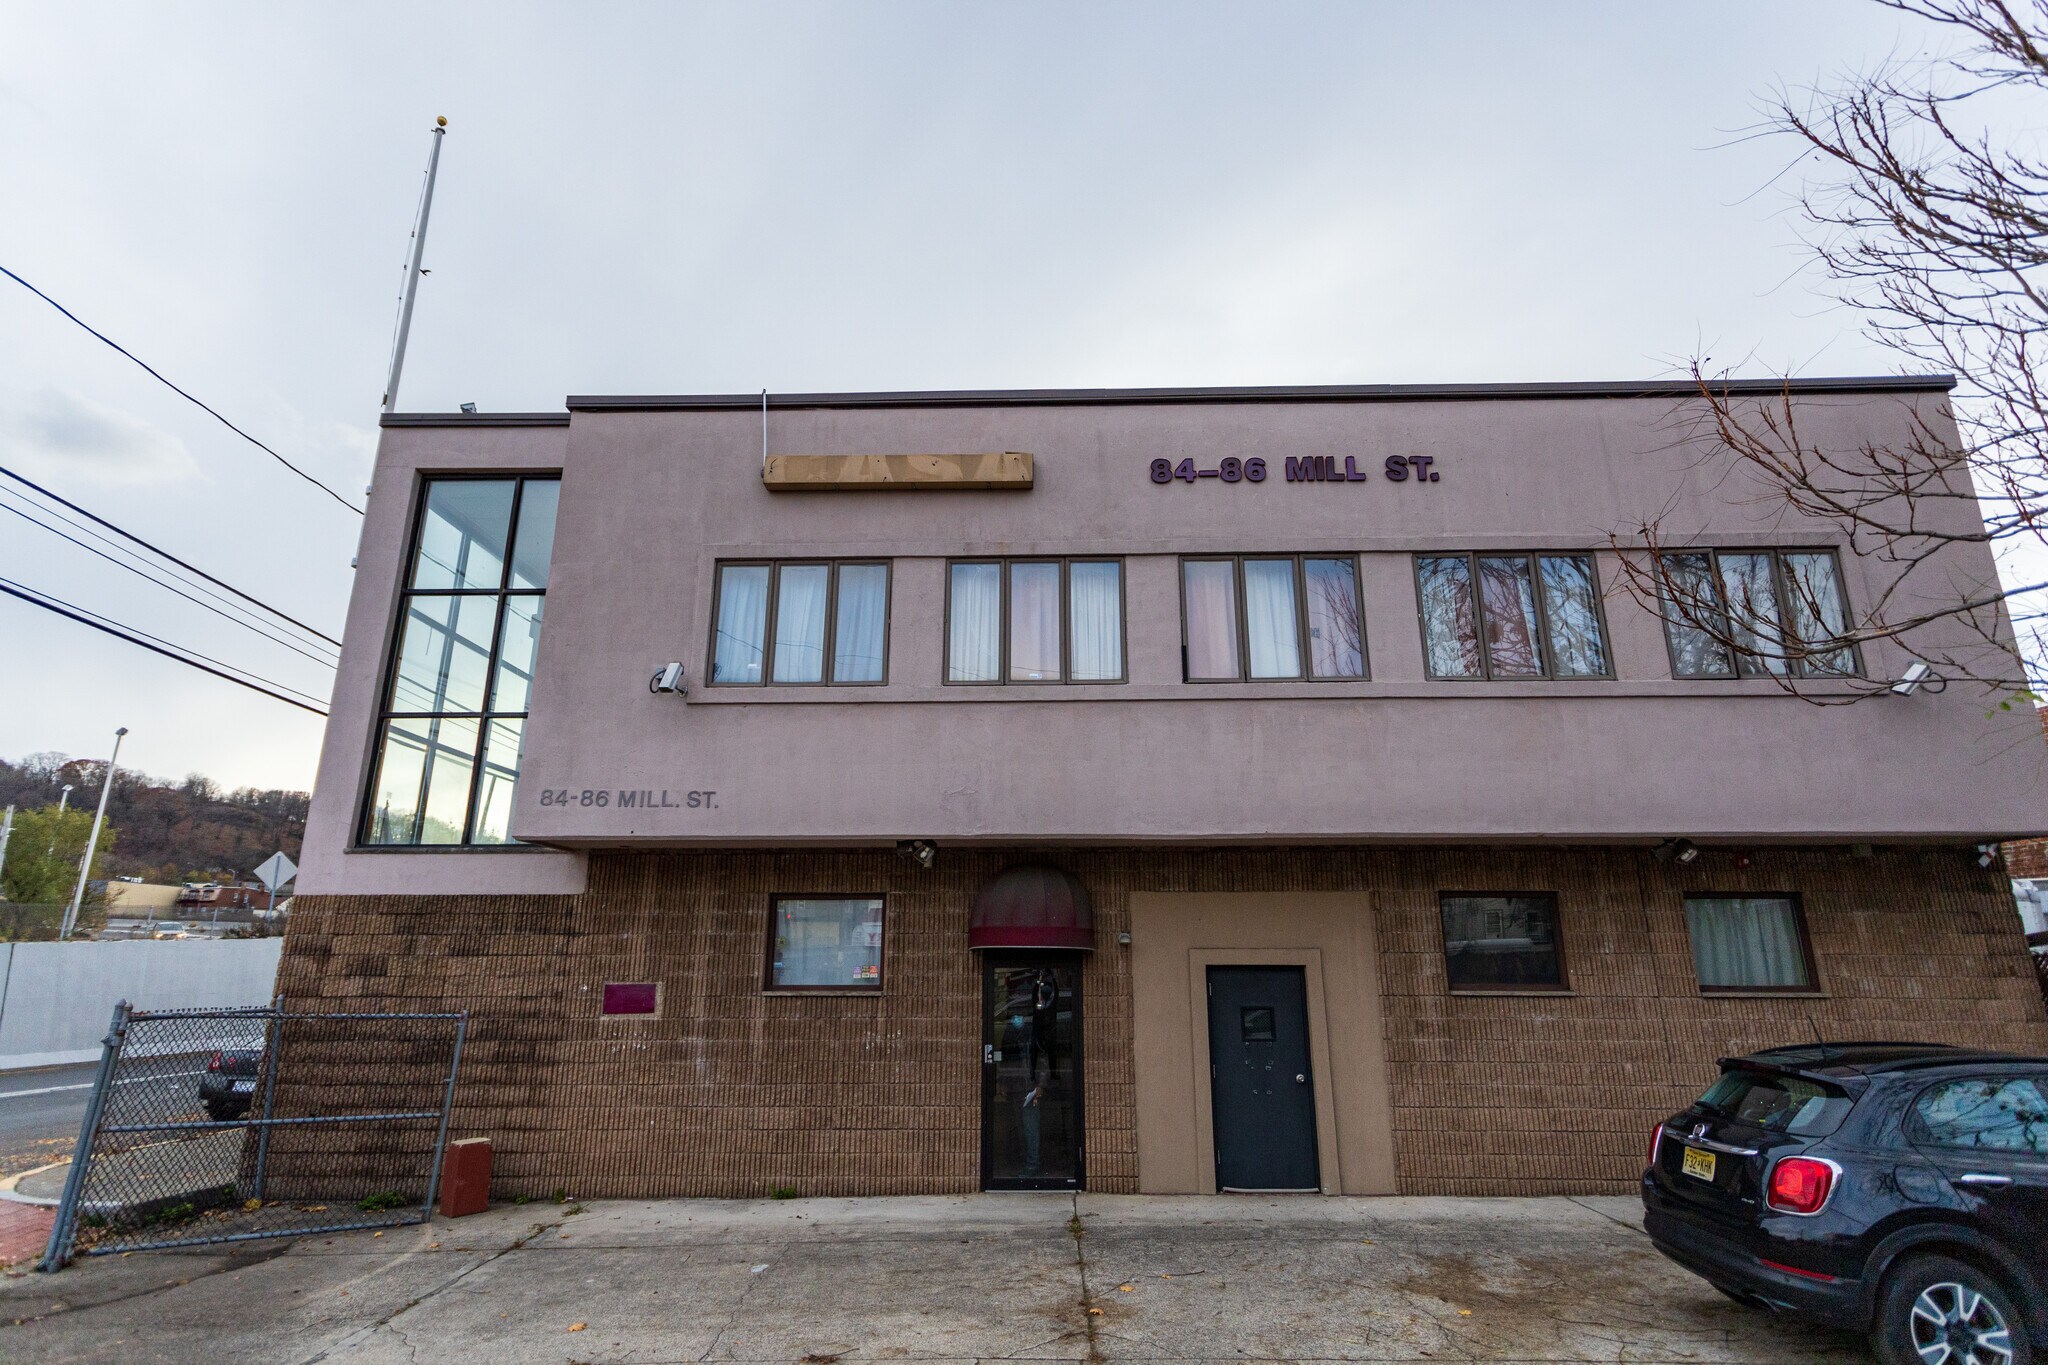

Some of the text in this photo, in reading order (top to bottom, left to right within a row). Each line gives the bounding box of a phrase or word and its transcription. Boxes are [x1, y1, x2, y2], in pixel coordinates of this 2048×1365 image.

[1150, 454, 1440, 484] 84-86 MILL ST.
[540, 789, 720, 809] 84-86 MILL. ST.
